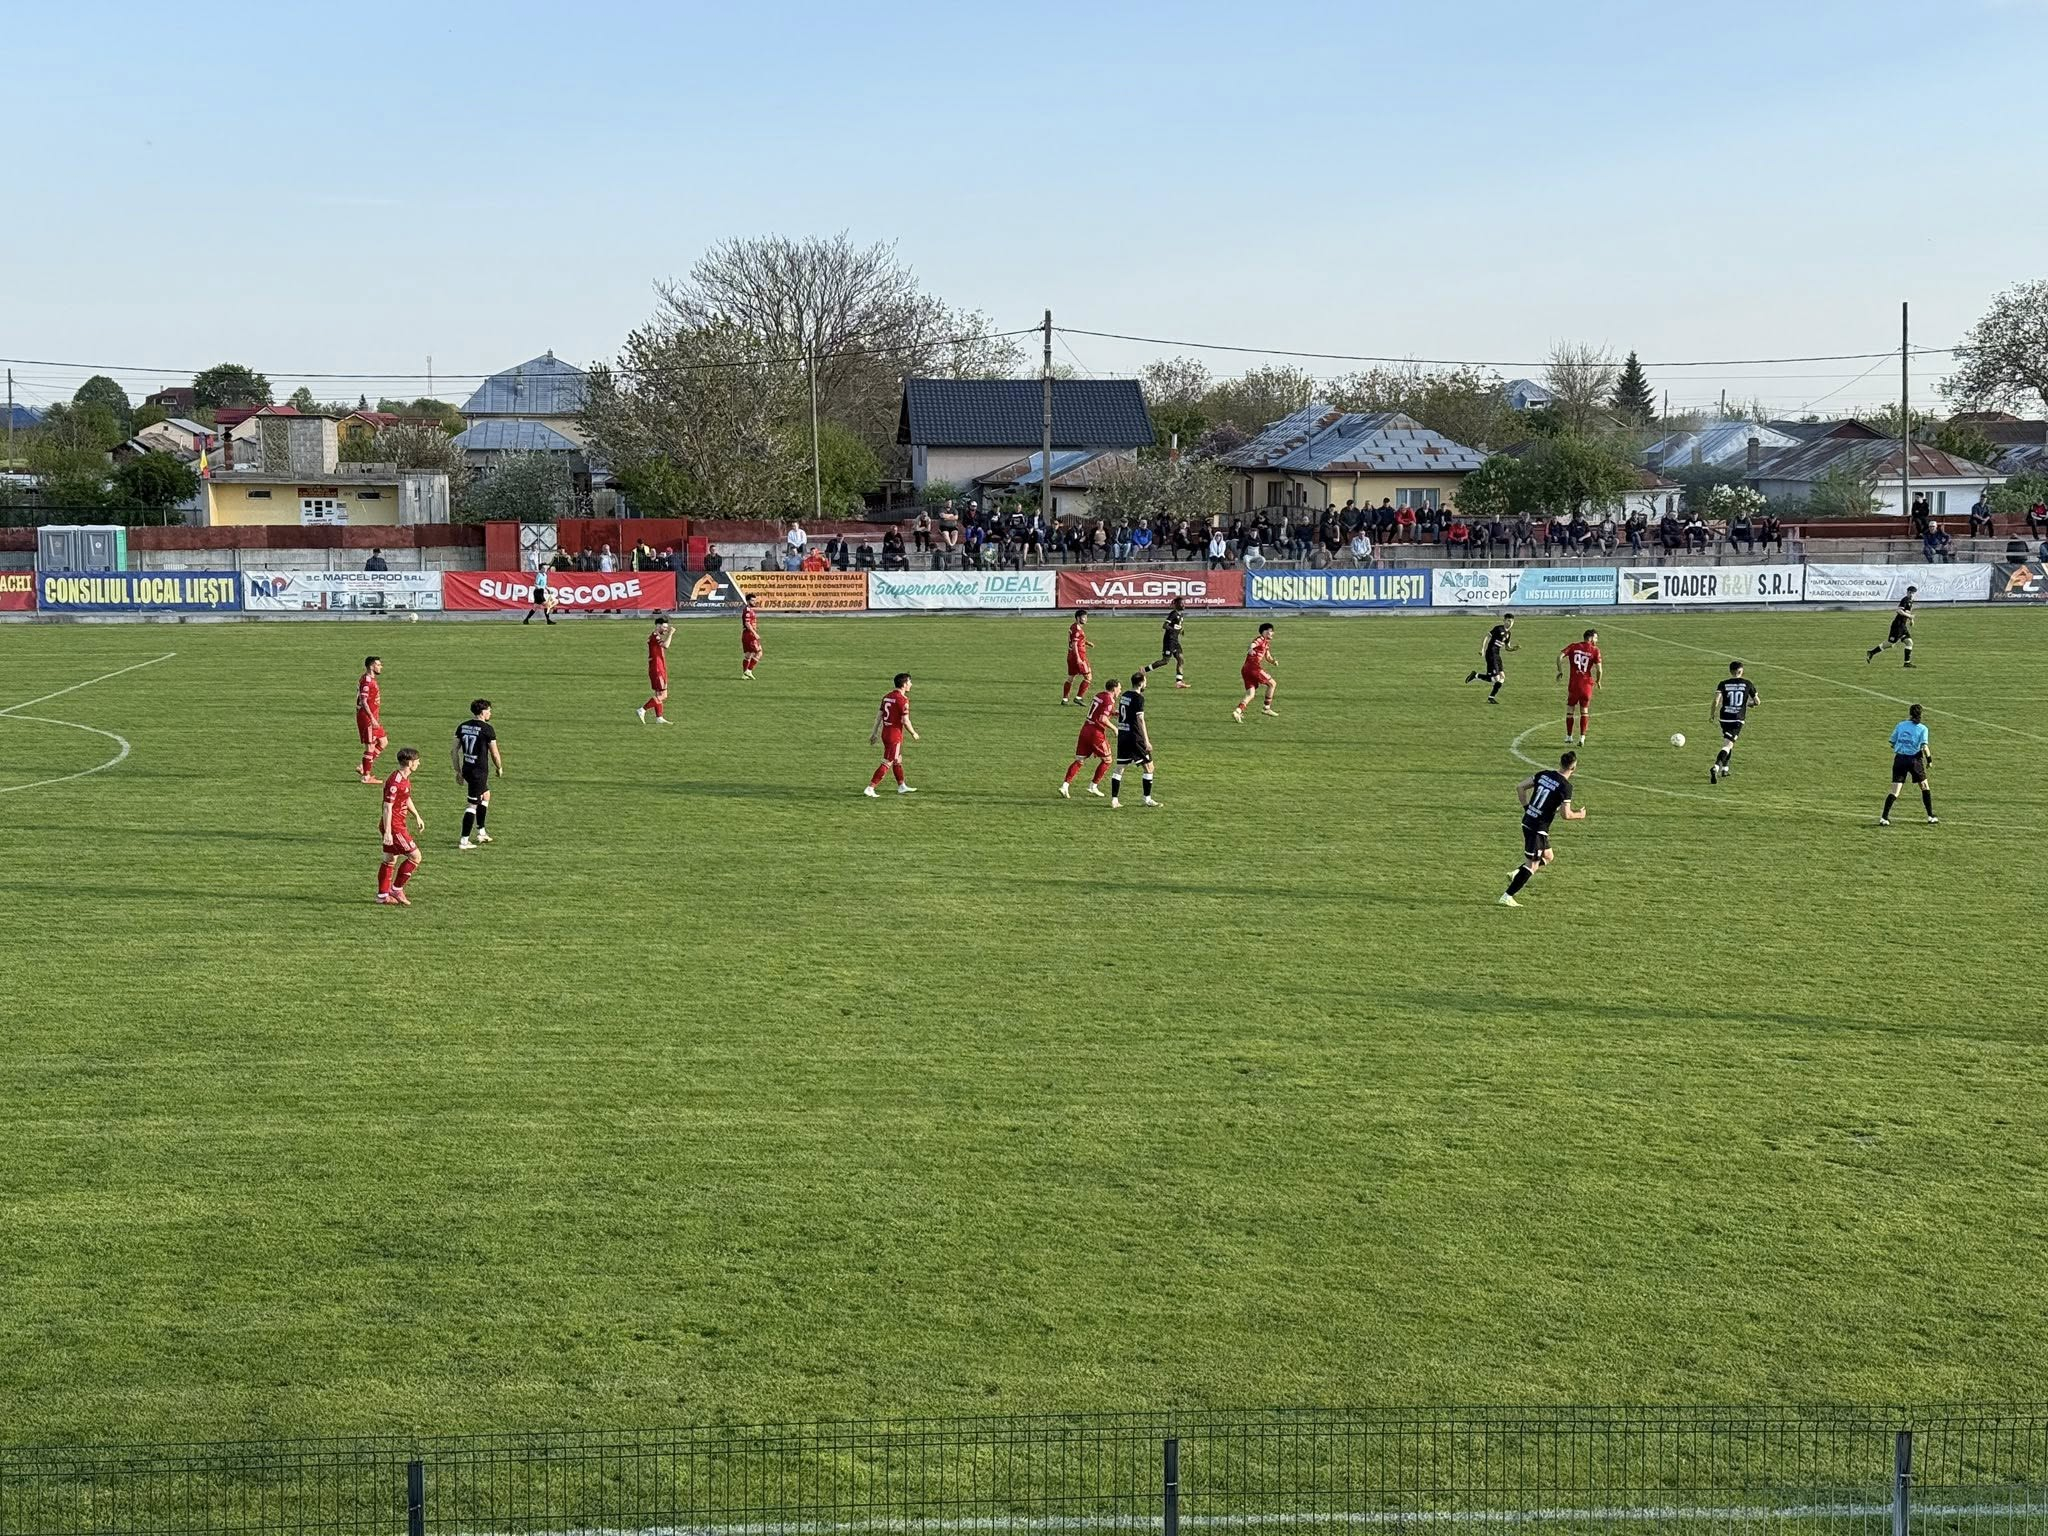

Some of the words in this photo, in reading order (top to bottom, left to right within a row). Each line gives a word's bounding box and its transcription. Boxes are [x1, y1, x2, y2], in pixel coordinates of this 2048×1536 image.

[323, 573, 370, 581] MARCEL
[371, 573, 403, 581] PROD
[985, 576, 1044, 592] IDEAL
[1440, 570, 1489, 588] Atria
[1664, 575, 1718, 597] TOADER
[1758, 573, 1799, 595] S.R.L.
[45, 577, 130, 604] CONSILIUL
[132, 577, 183, 604] LOCAL
[875, 580, 979, 598] Supermarket
[1090, 581, 1207, 597] VALGRIG
[1251, 575, 1329, 601] CONSILIUL
[1331, 575, 1377, 601] LOCAL
[1571, 589, 1614, 599] ELECTRICE
[979, 595, 1013, 603] PENTRU
[1014, 595, 1037, 603] CASA
[1040, 595, 1050, 603] TA
[1574, 653, 1590, 673] 99
[1727, 690, 1744, 707] 10
[884, 702, 892, 720] 5
[1120, 704, 1127, 723] 9
[462, 734, 477, 755] 17
[1532, 785, 1550, 810] 11
